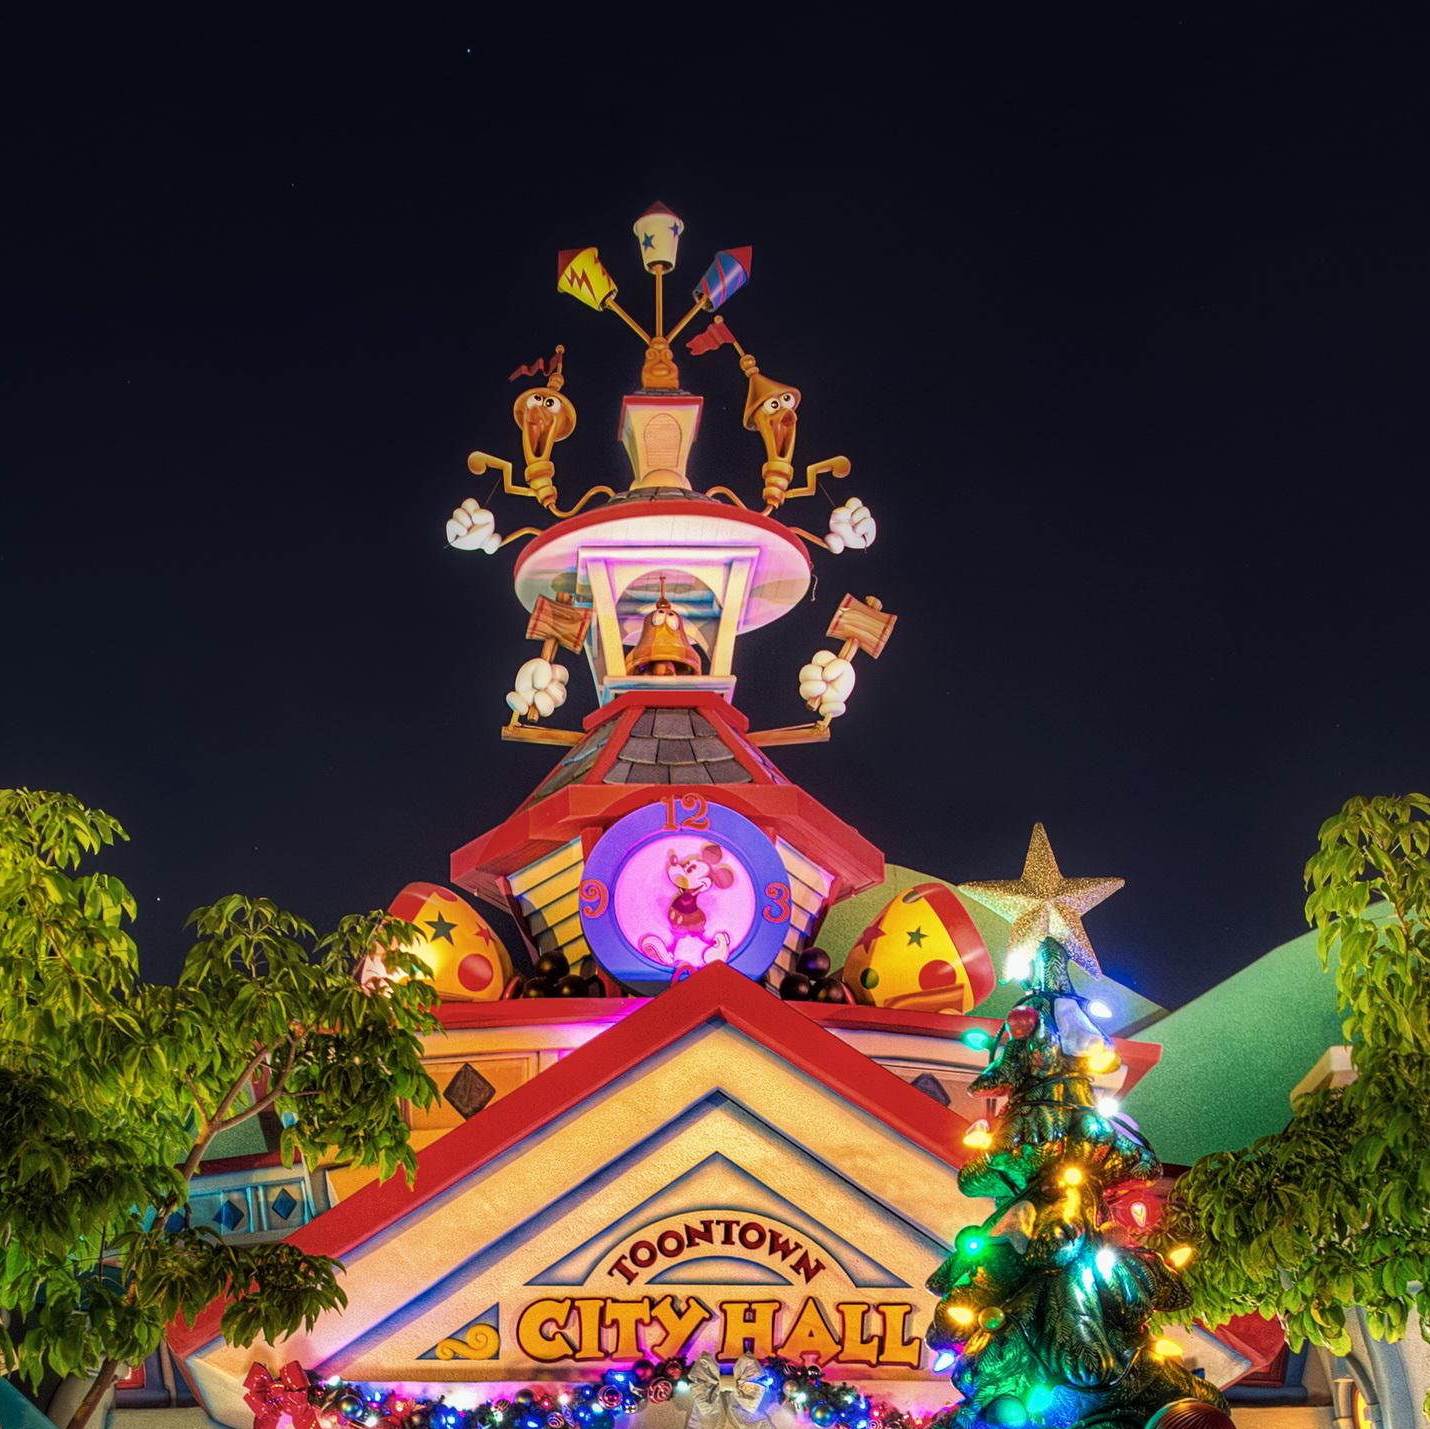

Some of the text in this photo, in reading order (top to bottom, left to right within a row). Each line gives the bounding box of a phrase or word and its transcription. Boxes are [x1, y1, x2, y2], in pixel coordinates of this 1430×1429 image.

[660, 793, 710, 831] 12
[579, 879, 610, 919] 9
[762, 882, 793, 923] 3
[607, 1218, 826, 1286] TOONTOWN
[516, 1295, 925, 1370] CITY HALL
